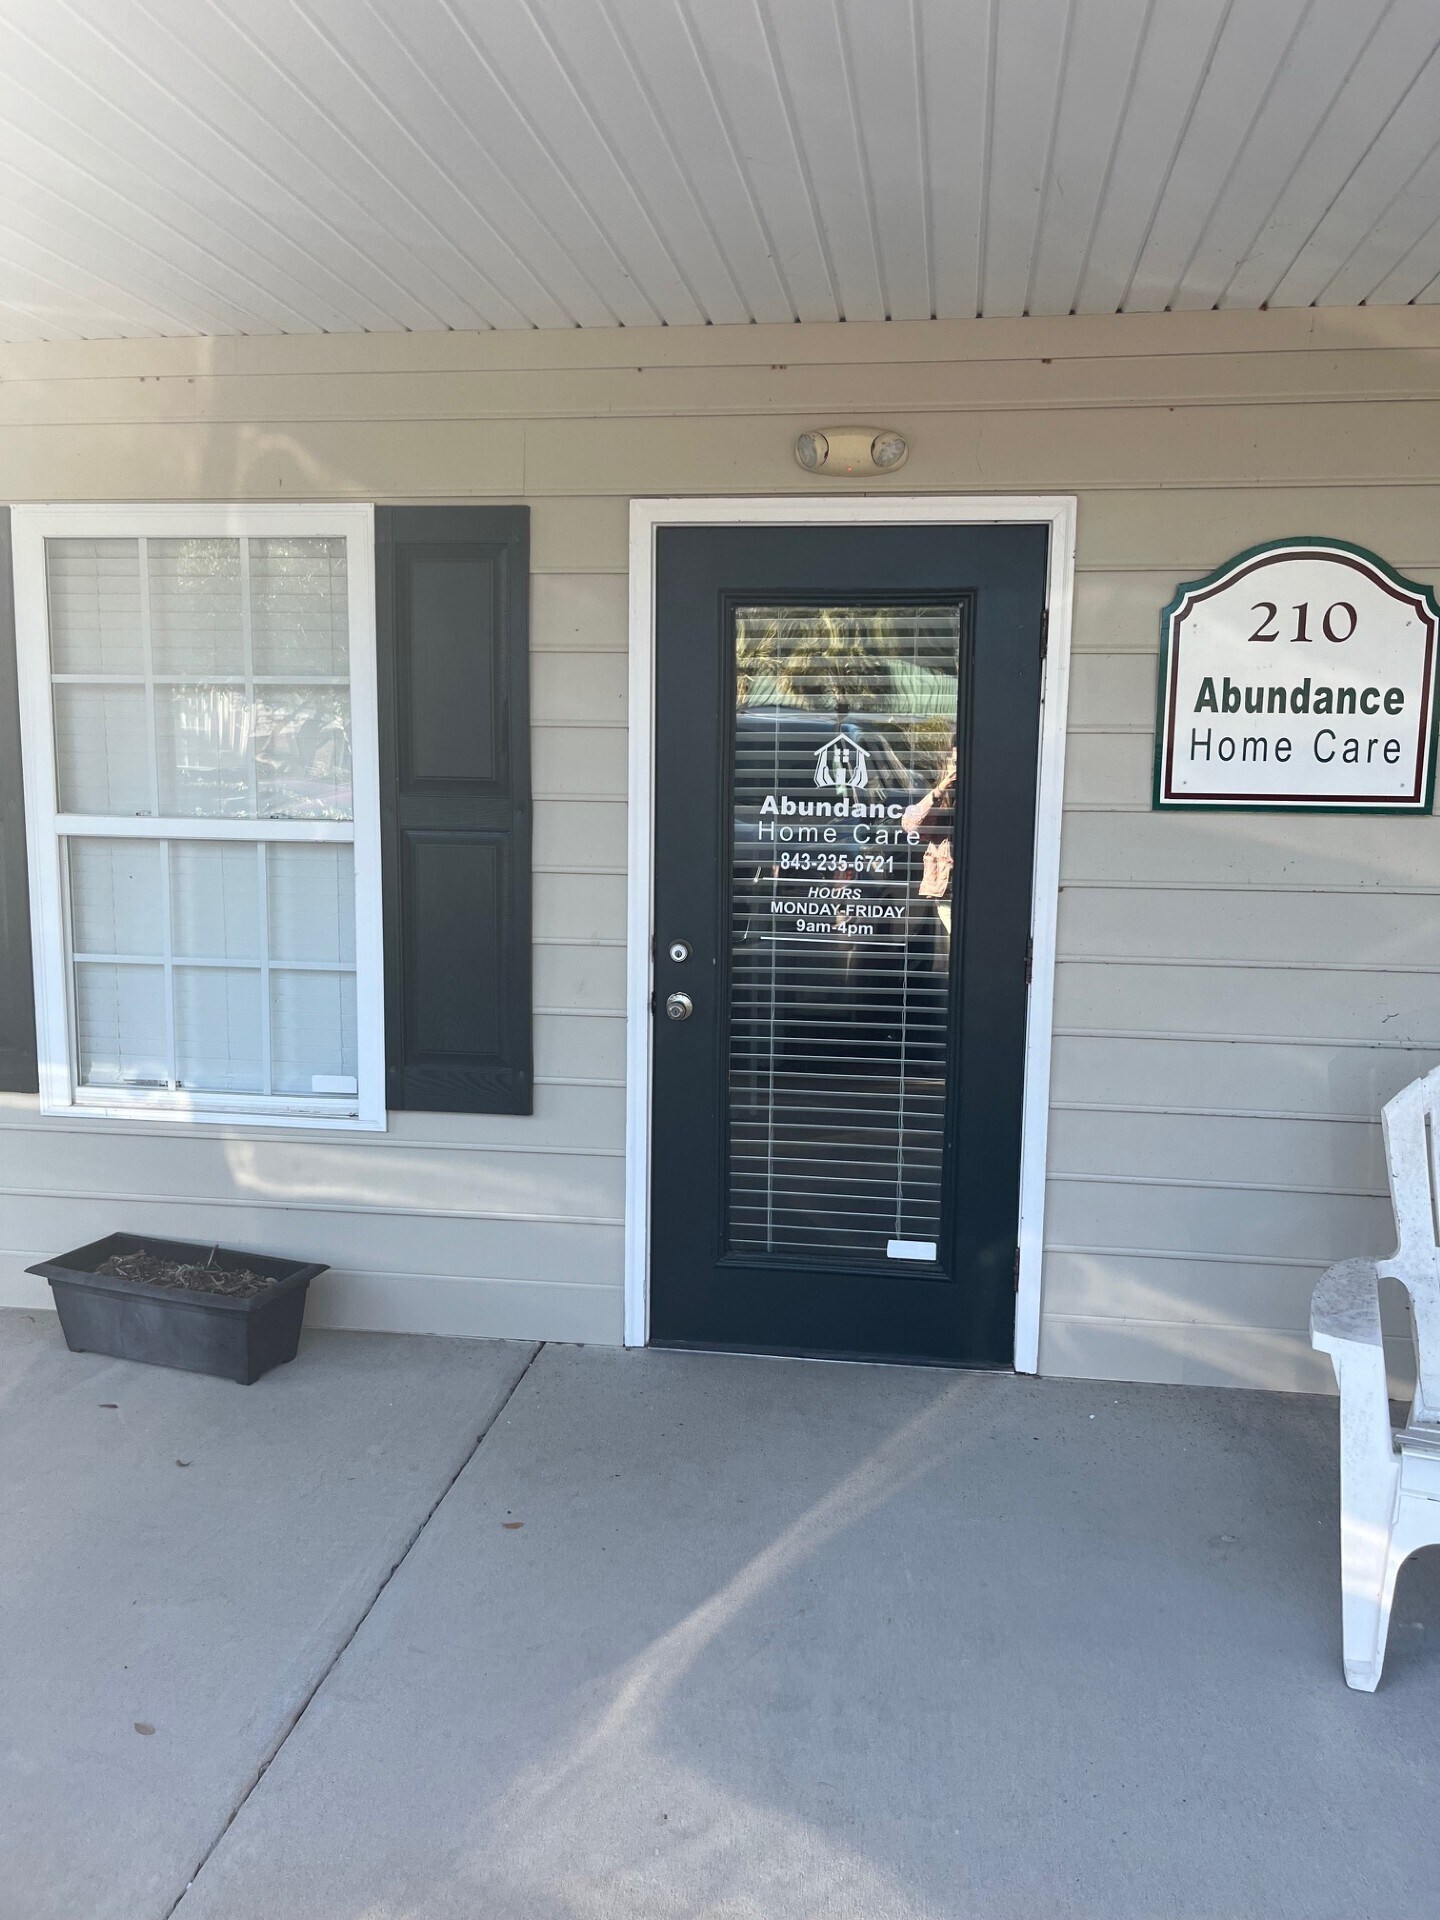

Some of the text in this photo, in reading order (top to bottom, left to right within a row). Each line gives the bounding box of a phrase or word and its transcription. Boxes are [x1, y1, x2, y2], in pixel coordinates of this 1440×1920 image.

[1247, 601, 1358, 643] 210
[1193, 676, 1405, 715] Abundance
[1190, 727, 1401, 764] Home Care
[758, 822, 920, 845] Home Care
[780, 852, 894, 873] 843-235-6721
[808, 887, 862, 899] HOURS
[770, 901, 905, 918] MONDAY-FRIDAY
[796, 919, 874, 936] 9am-4pm
